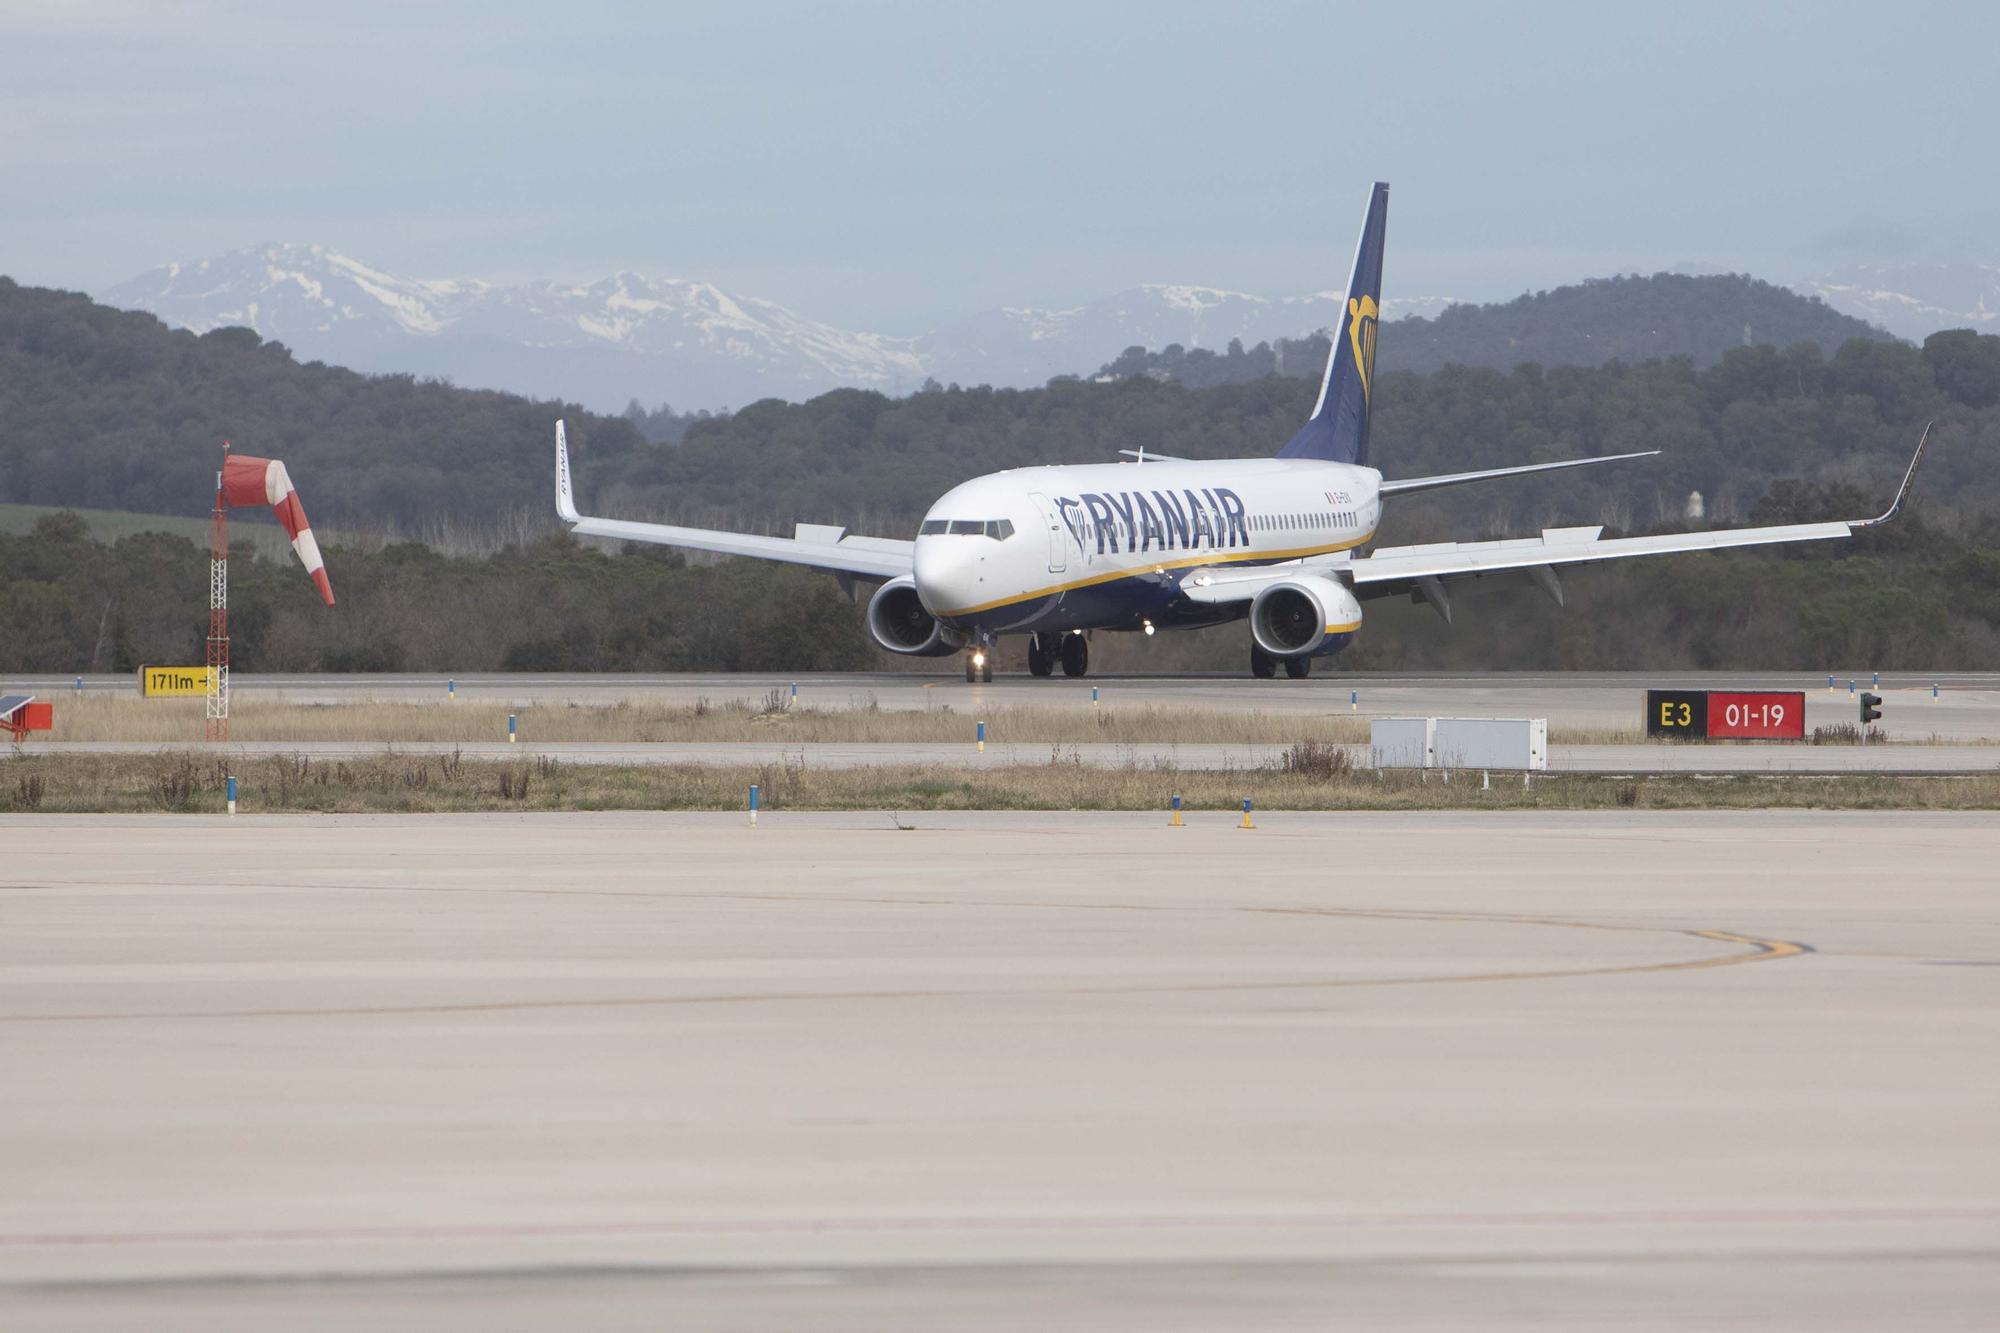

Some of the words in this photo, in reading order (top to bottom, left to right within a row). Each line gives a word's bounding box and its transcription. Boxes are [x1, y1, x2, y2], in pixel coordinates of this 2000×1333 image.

[1079, 488, 1250, 554] RYANAIR
[152, 674, 193, 689] 1711m
[1661, 702, 1692, 726] E3
[1725, 704, 1785, 727] 01-19
